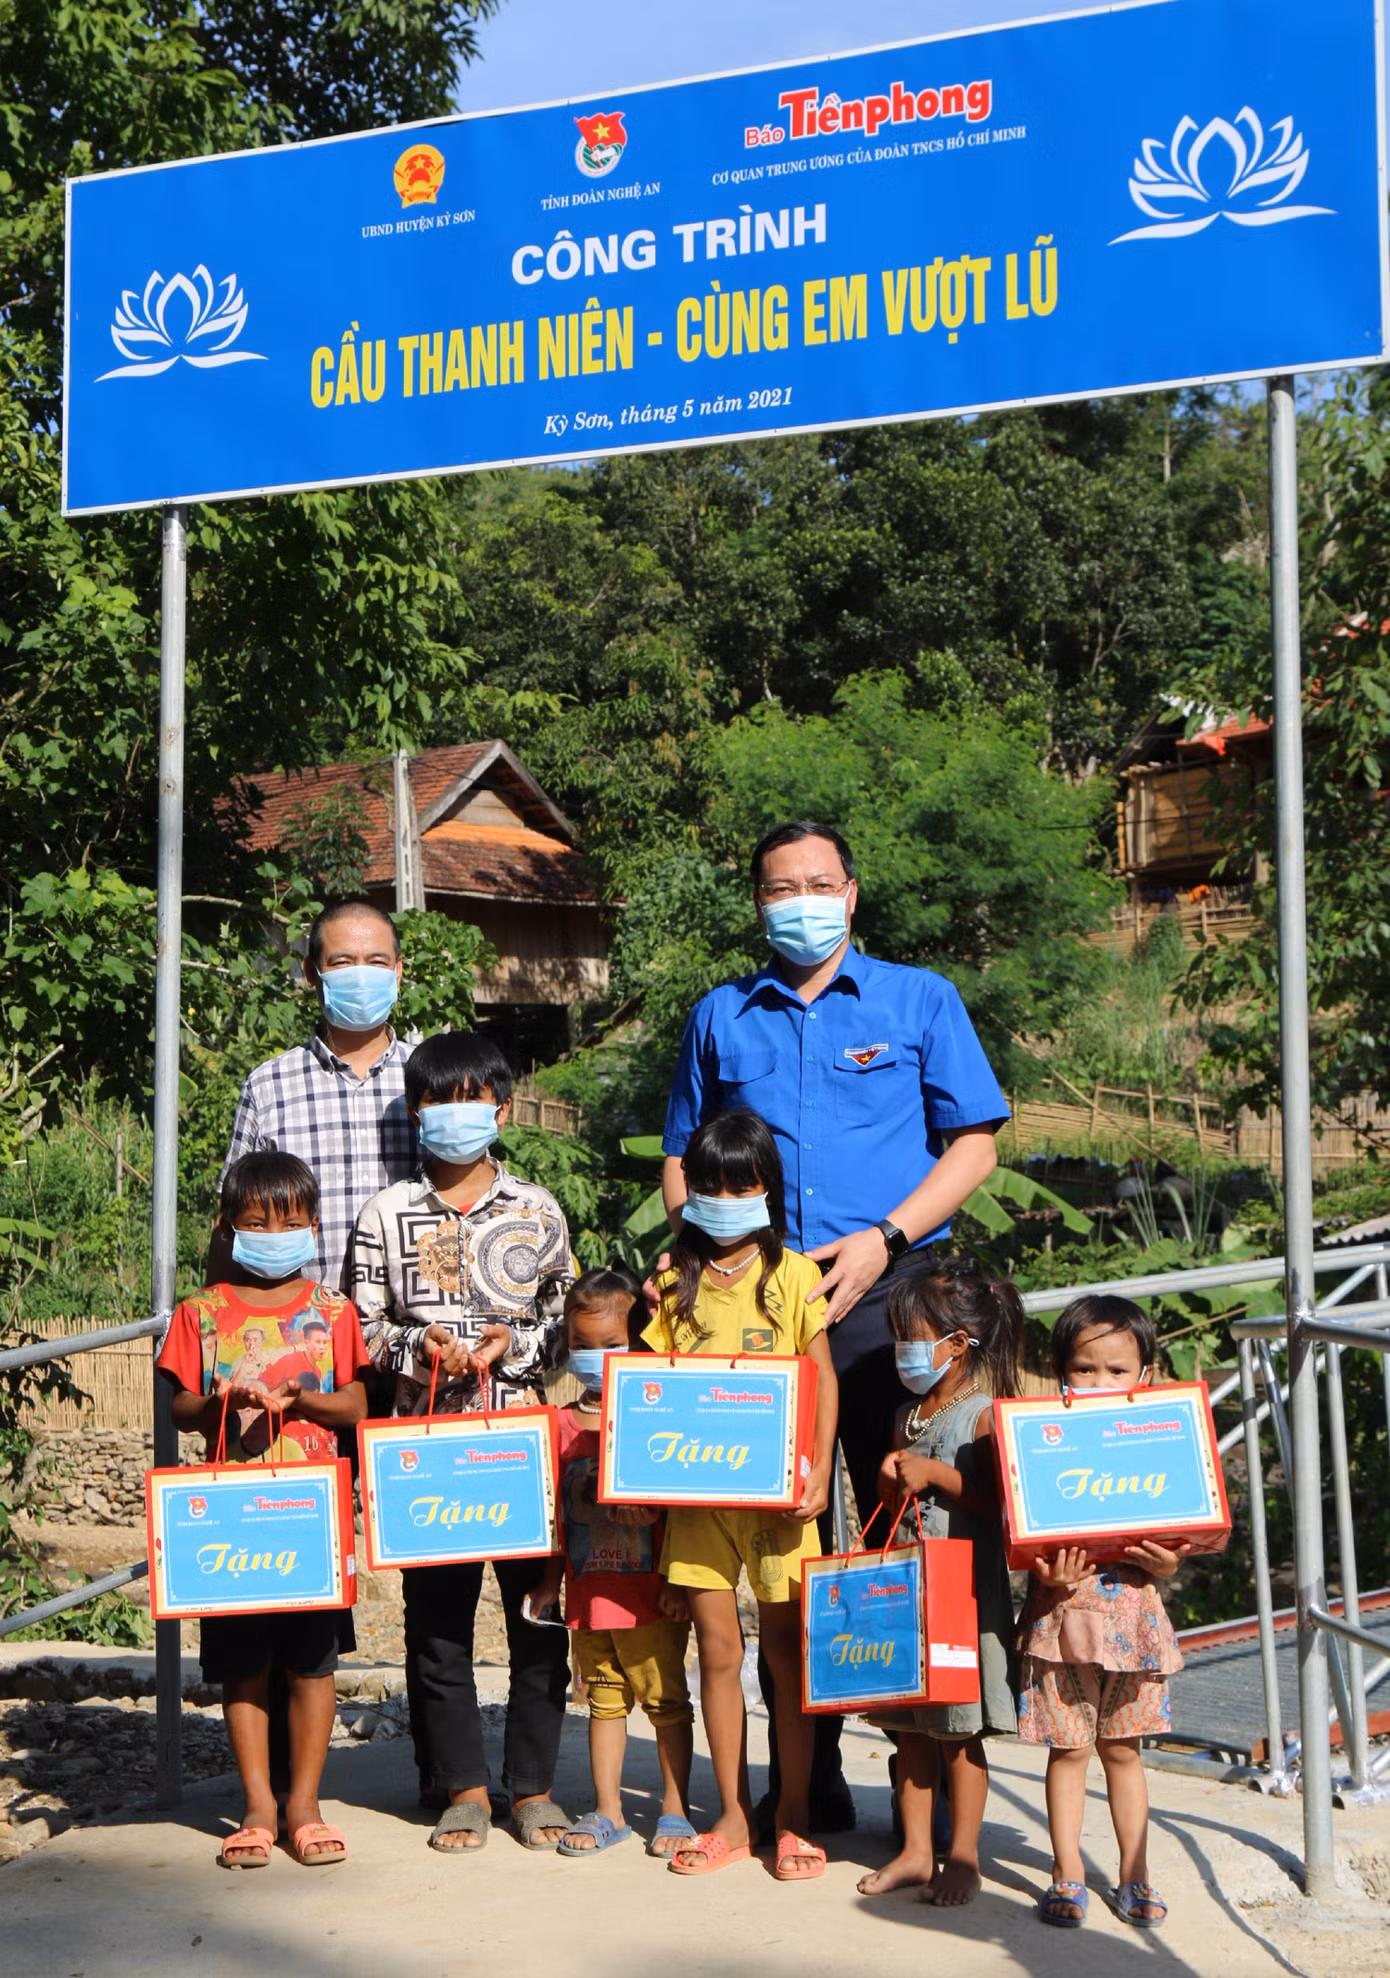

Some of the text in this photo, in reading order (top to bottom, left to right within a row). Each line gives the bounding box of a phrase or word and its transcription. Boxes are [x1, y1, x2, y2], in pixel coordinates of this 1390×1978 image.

[744, 79, 992, 148] Báo Tiềnphong
[712, 125, 1026, 185] CƠ QUAN TRUNG ƯƠNG CỦA ĐOÀN TNCS HỒ CHÍ MINH
[541, 182, 661, 211] TỈNH ĐOÀN NGHỆ AN
[361, 209, 476, 239] UBND HUYỆN KỲ SƠN
[511, 202, 827, 286] CÔNG TRÌNH
[310, 321, 386, 409] CẦU
[398, 319, 525, 398] THANH
[538, 296, 634, 381] NIÊN
[676, 280, 789, 363] CÙNG
[803, 273, 868, 346] EM
[881, 254, 991, 345] VƯỢT
[1005, 233, 1058, 321] LŨ
[543, 386, 793, 436] Kỳ Sơn, tháng 5 năm 2021
[648, 1431, 752, 1470] Tặng
[1056, 1468, 1170, 1502] Tặng
[409, 1496, 512, 1531] Tặng
[196, 1543, 301, 1578] Tặng
[593, 1549, 622, 1559] LOVE
[830, 1634, 896, 1670] Tặng
